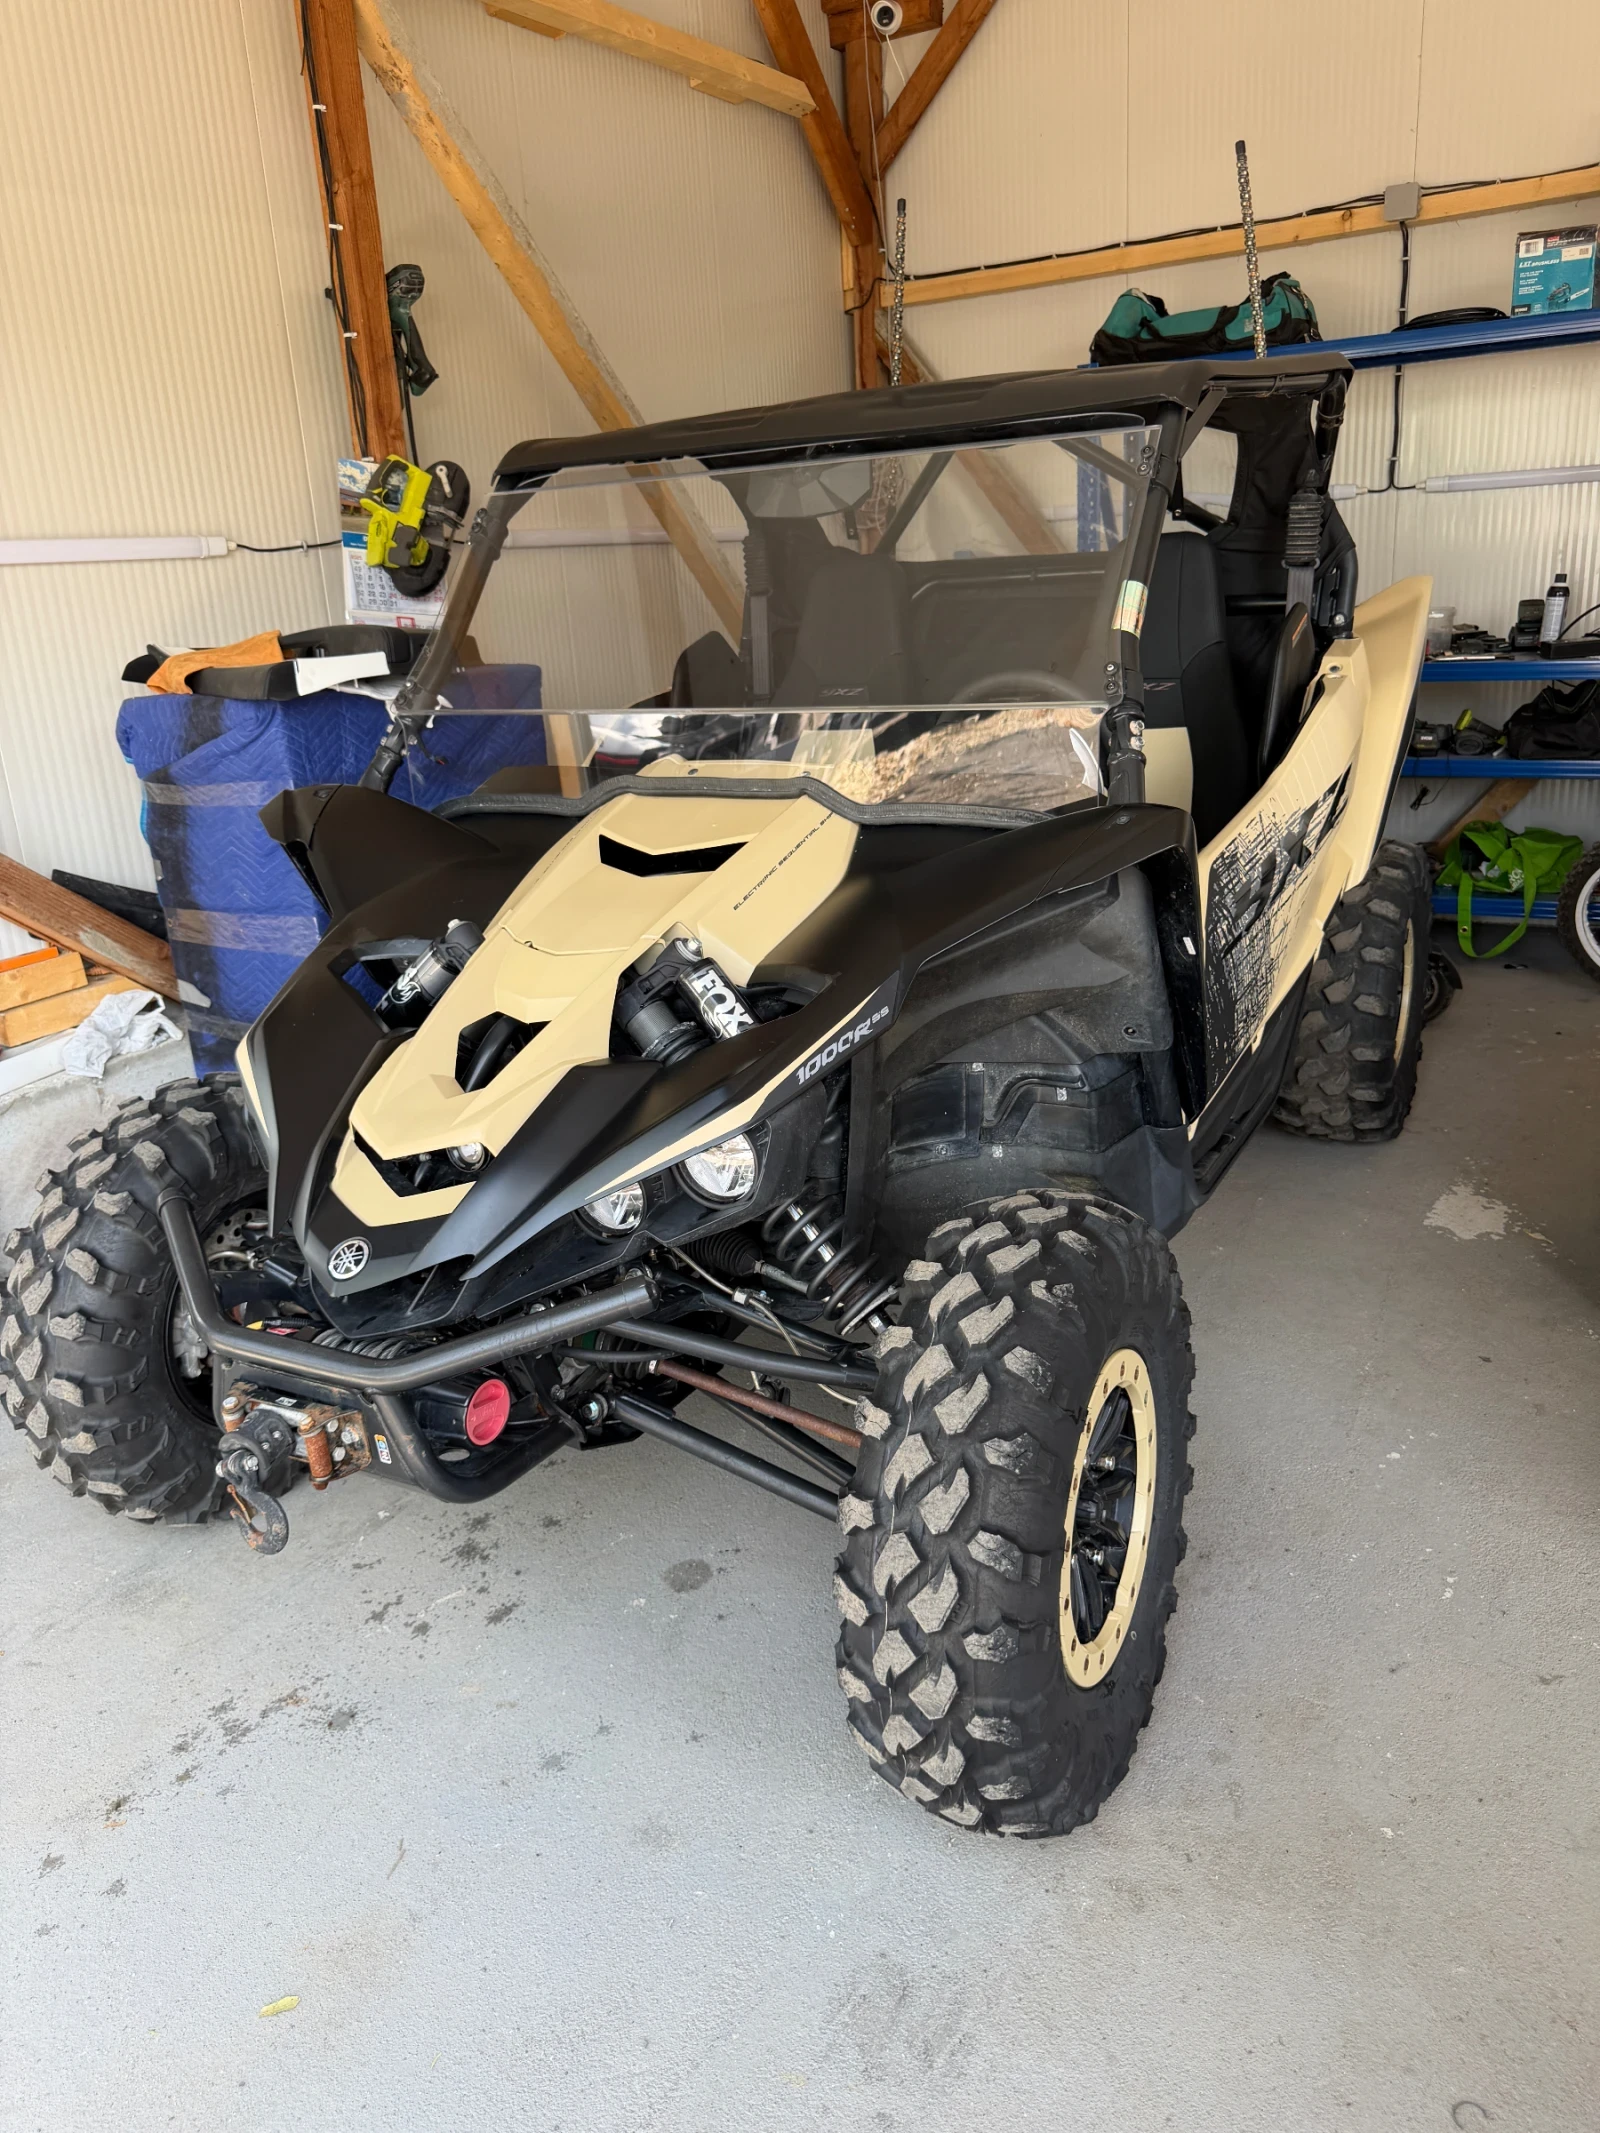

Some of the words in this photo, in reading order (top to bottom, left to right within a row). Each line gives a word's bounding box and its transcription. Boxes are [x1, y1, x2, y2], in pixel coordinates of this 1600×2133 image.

[1143, 682, 1177, 691] XZ
[733, 865, 778, 911] ELECTRONIC
[778, 826, 820, 867] SEQUENTIAL
[690, 967, 755, 1038] FOX
[795, 1016, 874, 1086] 1000R
